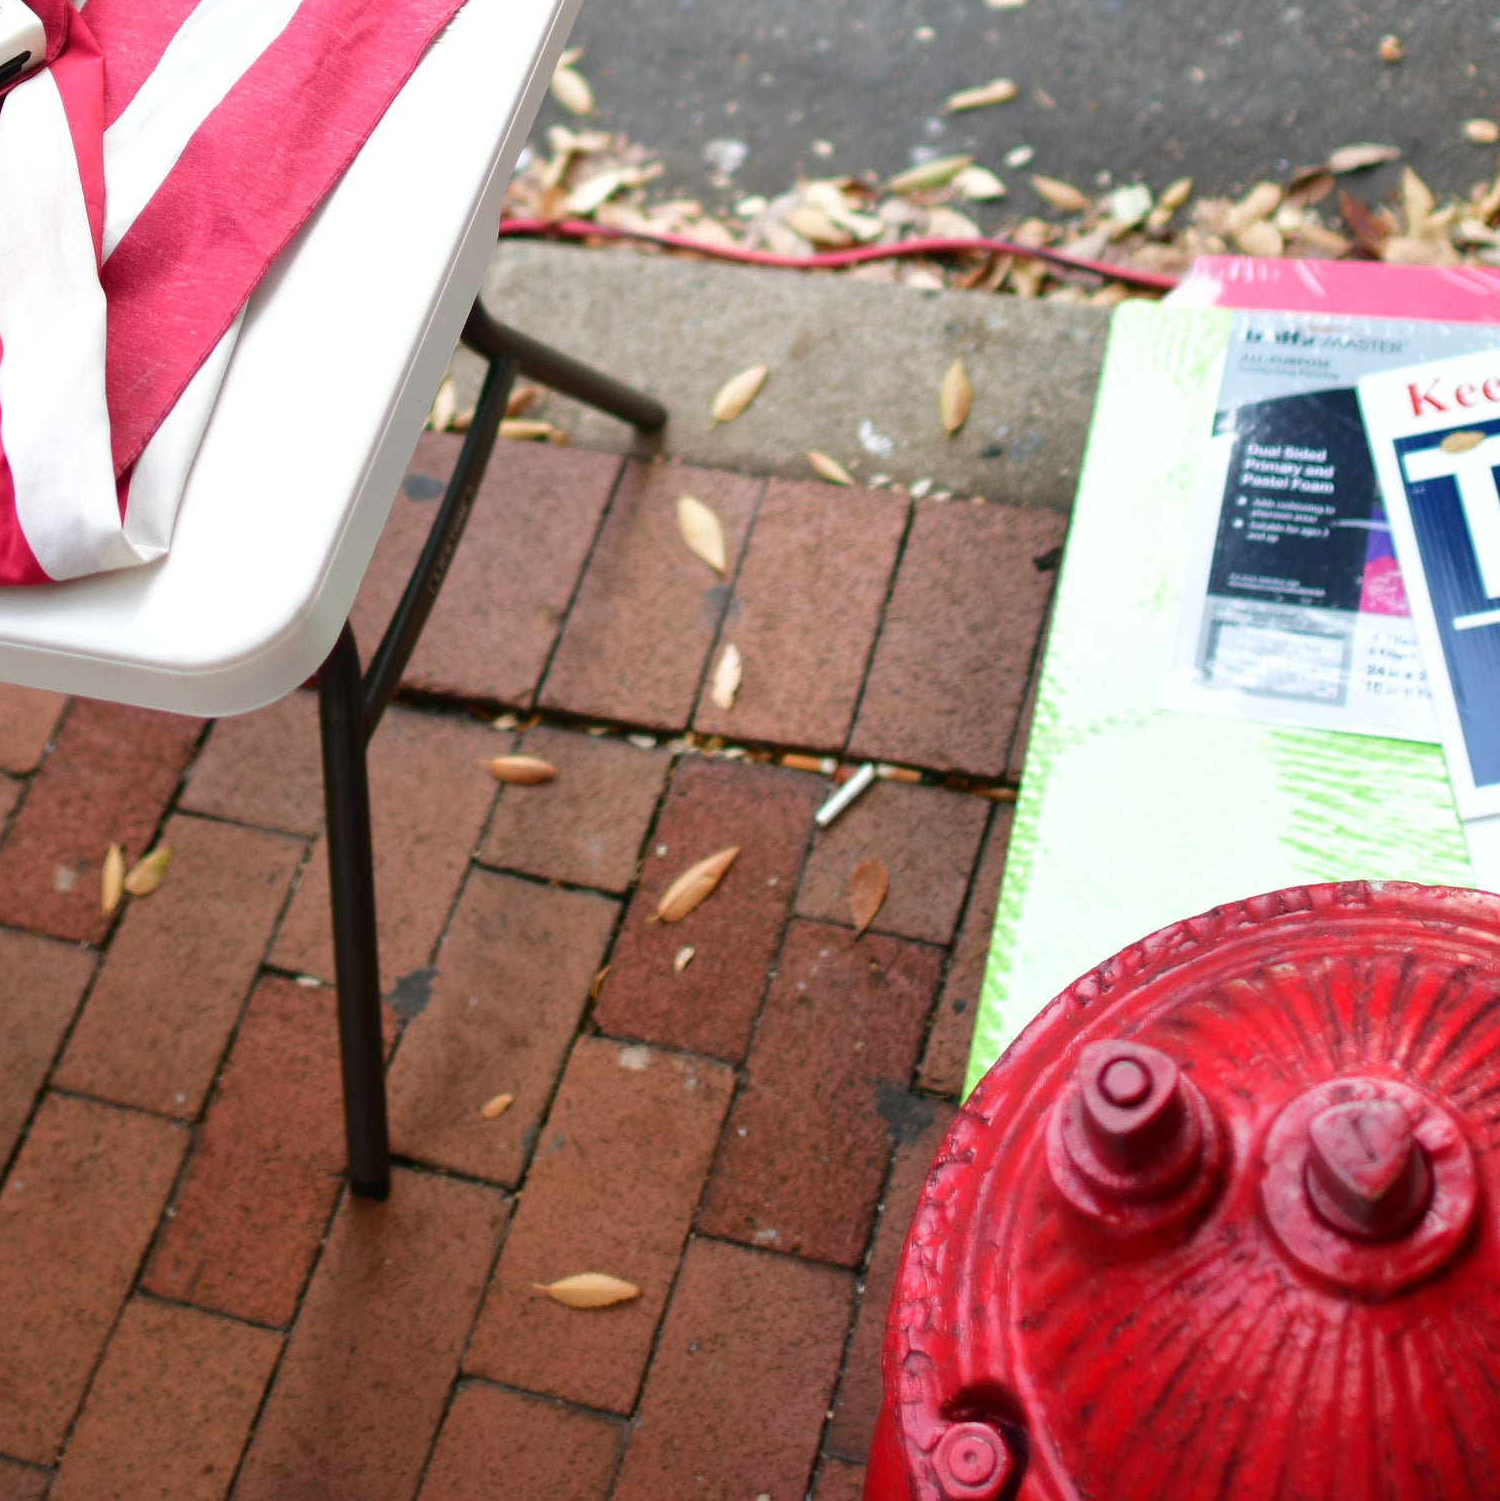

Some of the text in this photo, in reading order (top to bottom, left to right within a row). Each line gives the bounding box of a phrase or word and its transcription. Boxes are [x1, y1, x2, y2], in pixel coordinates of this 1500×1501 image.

[1247, 443, 1281, 458] Dual
[1244, 458, 1335, 480] Primary and
[1242, 473, 1335, 496] Pastel Foam
